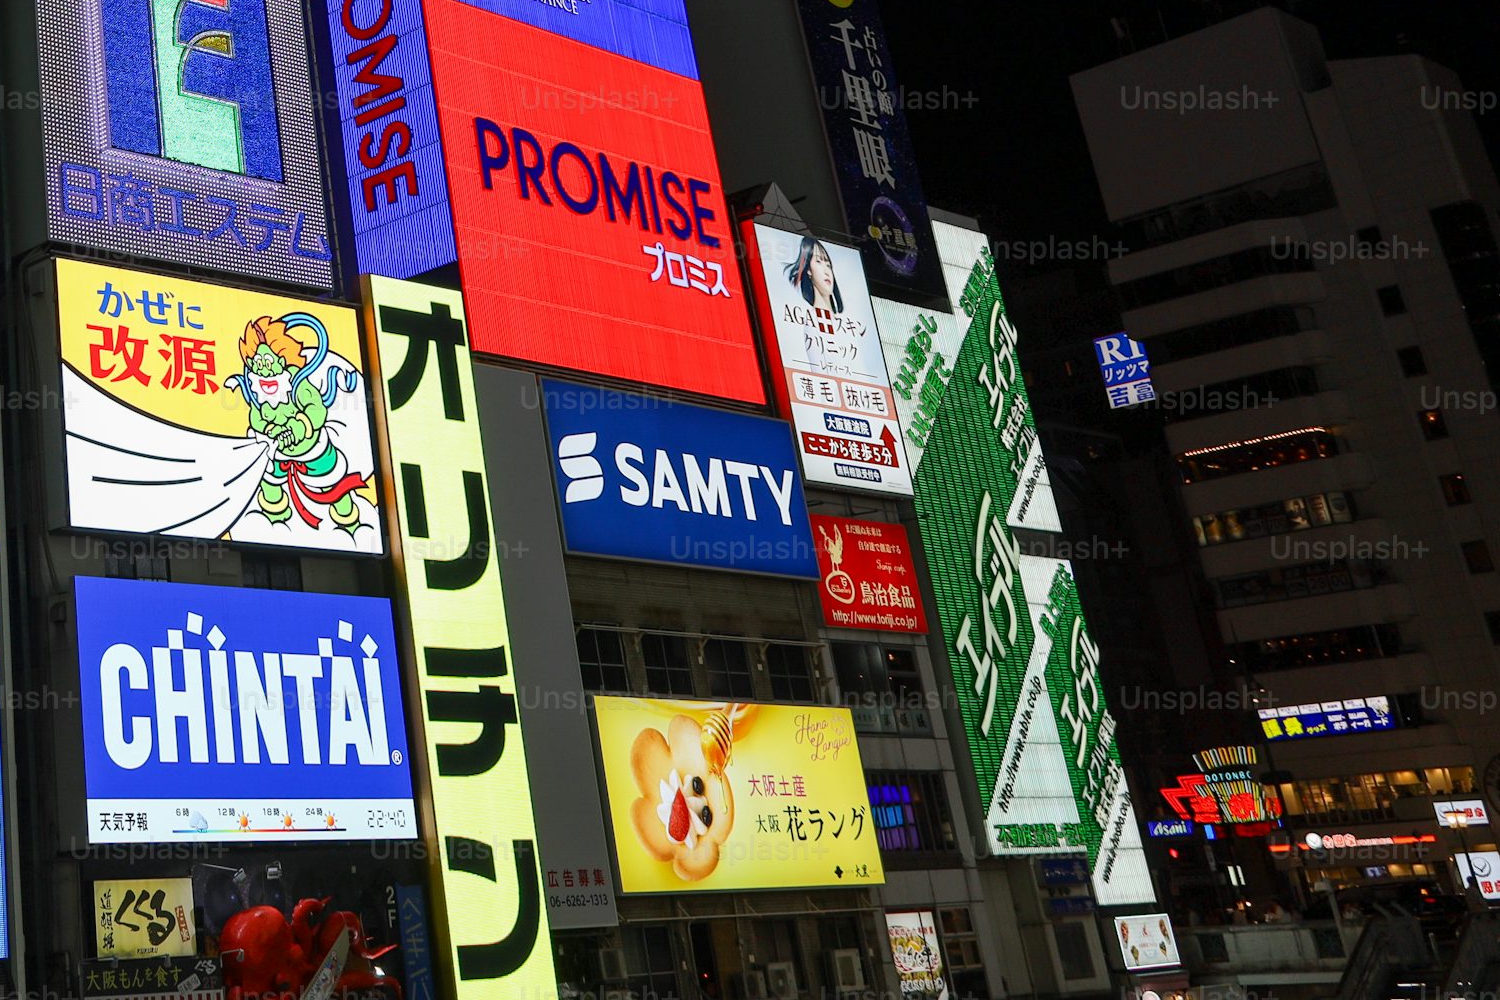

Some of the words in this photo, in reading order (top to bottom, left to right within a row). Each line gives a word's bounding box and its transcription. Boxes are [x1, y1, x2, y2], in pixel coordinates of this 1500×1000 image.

[474, 116, 721, 246] PROMISE
[61, 161, 334, 262] 日商エステム
[641, 241, 731, 299] プロミス
[96, 282, 204, 330] かぜに
[783, 303, 816, 328] AGA
[835, 316, 867, 337] スキン
[86, 323, 219, 395] 改源
[804, 333, 858, 361] クリニック
[800, 377, 834, 402] 薄毛
[845, 386, 885, 413] 抜け毛
[808, 436, 893, 465] ここから徒歩5分
[615, 440, 794, 526] SAMTY
[748, 774, 807, 798] 大阪土産
[99, 812, 149, 832] 天気予報
[755, 814, 781, 834] 大阪
[783, 804, 866, 842] 花ラング
[547, 868, 605, 888] 広告募集
